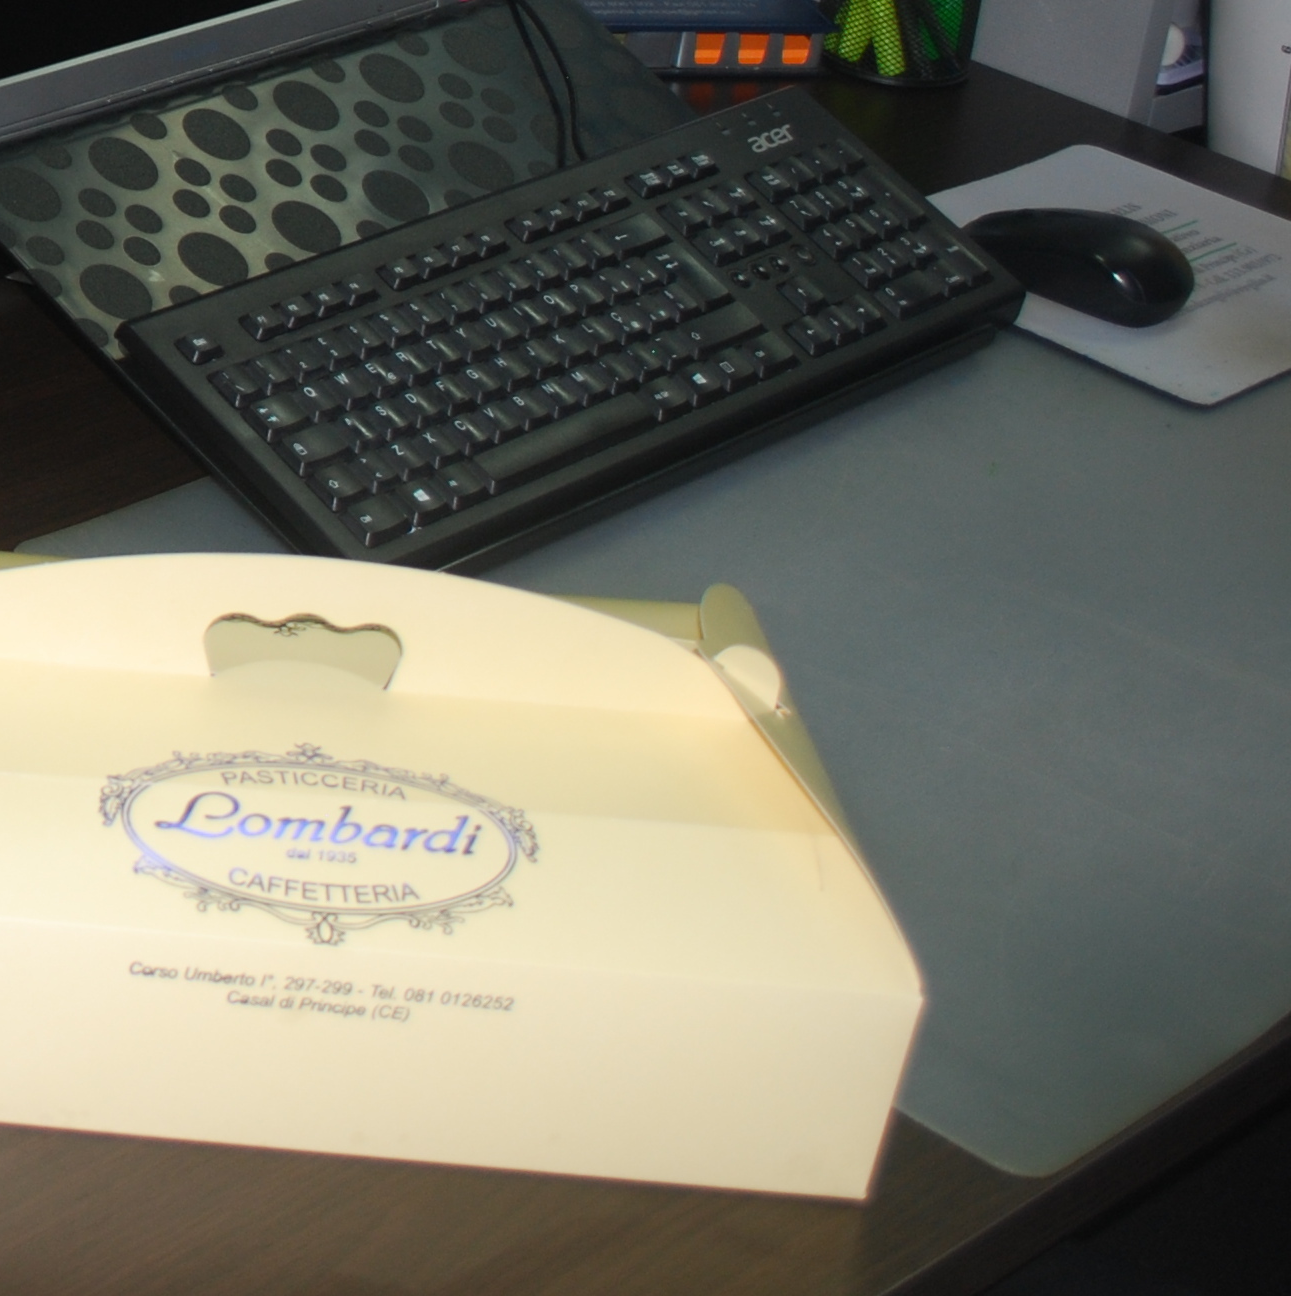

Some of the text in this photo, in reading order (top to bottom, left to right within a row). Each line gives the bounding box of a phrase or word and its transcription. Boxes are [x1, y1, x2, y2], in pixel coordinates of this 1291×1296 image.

[747, 124, 793, 153] acer
[220, 768, 408, 801] PASTICCERIA
[154, 790, 484, 857] Lombardi
[286, 847, 312, 861] dal
[227, 866, 422, 905] CAFFETTERIA
[128, 960, 179, 980] Corso
[183, 966, 256, 987] Umberto
[283, 976, 354, 997] 297-299
[370, 983, 398, 1001] Tel.
[403, 986, 436, 1003] 081
[439, 990, 516, 1012] 0126252
[226, 990, 412, 1023] Casal di Principe (CE)
